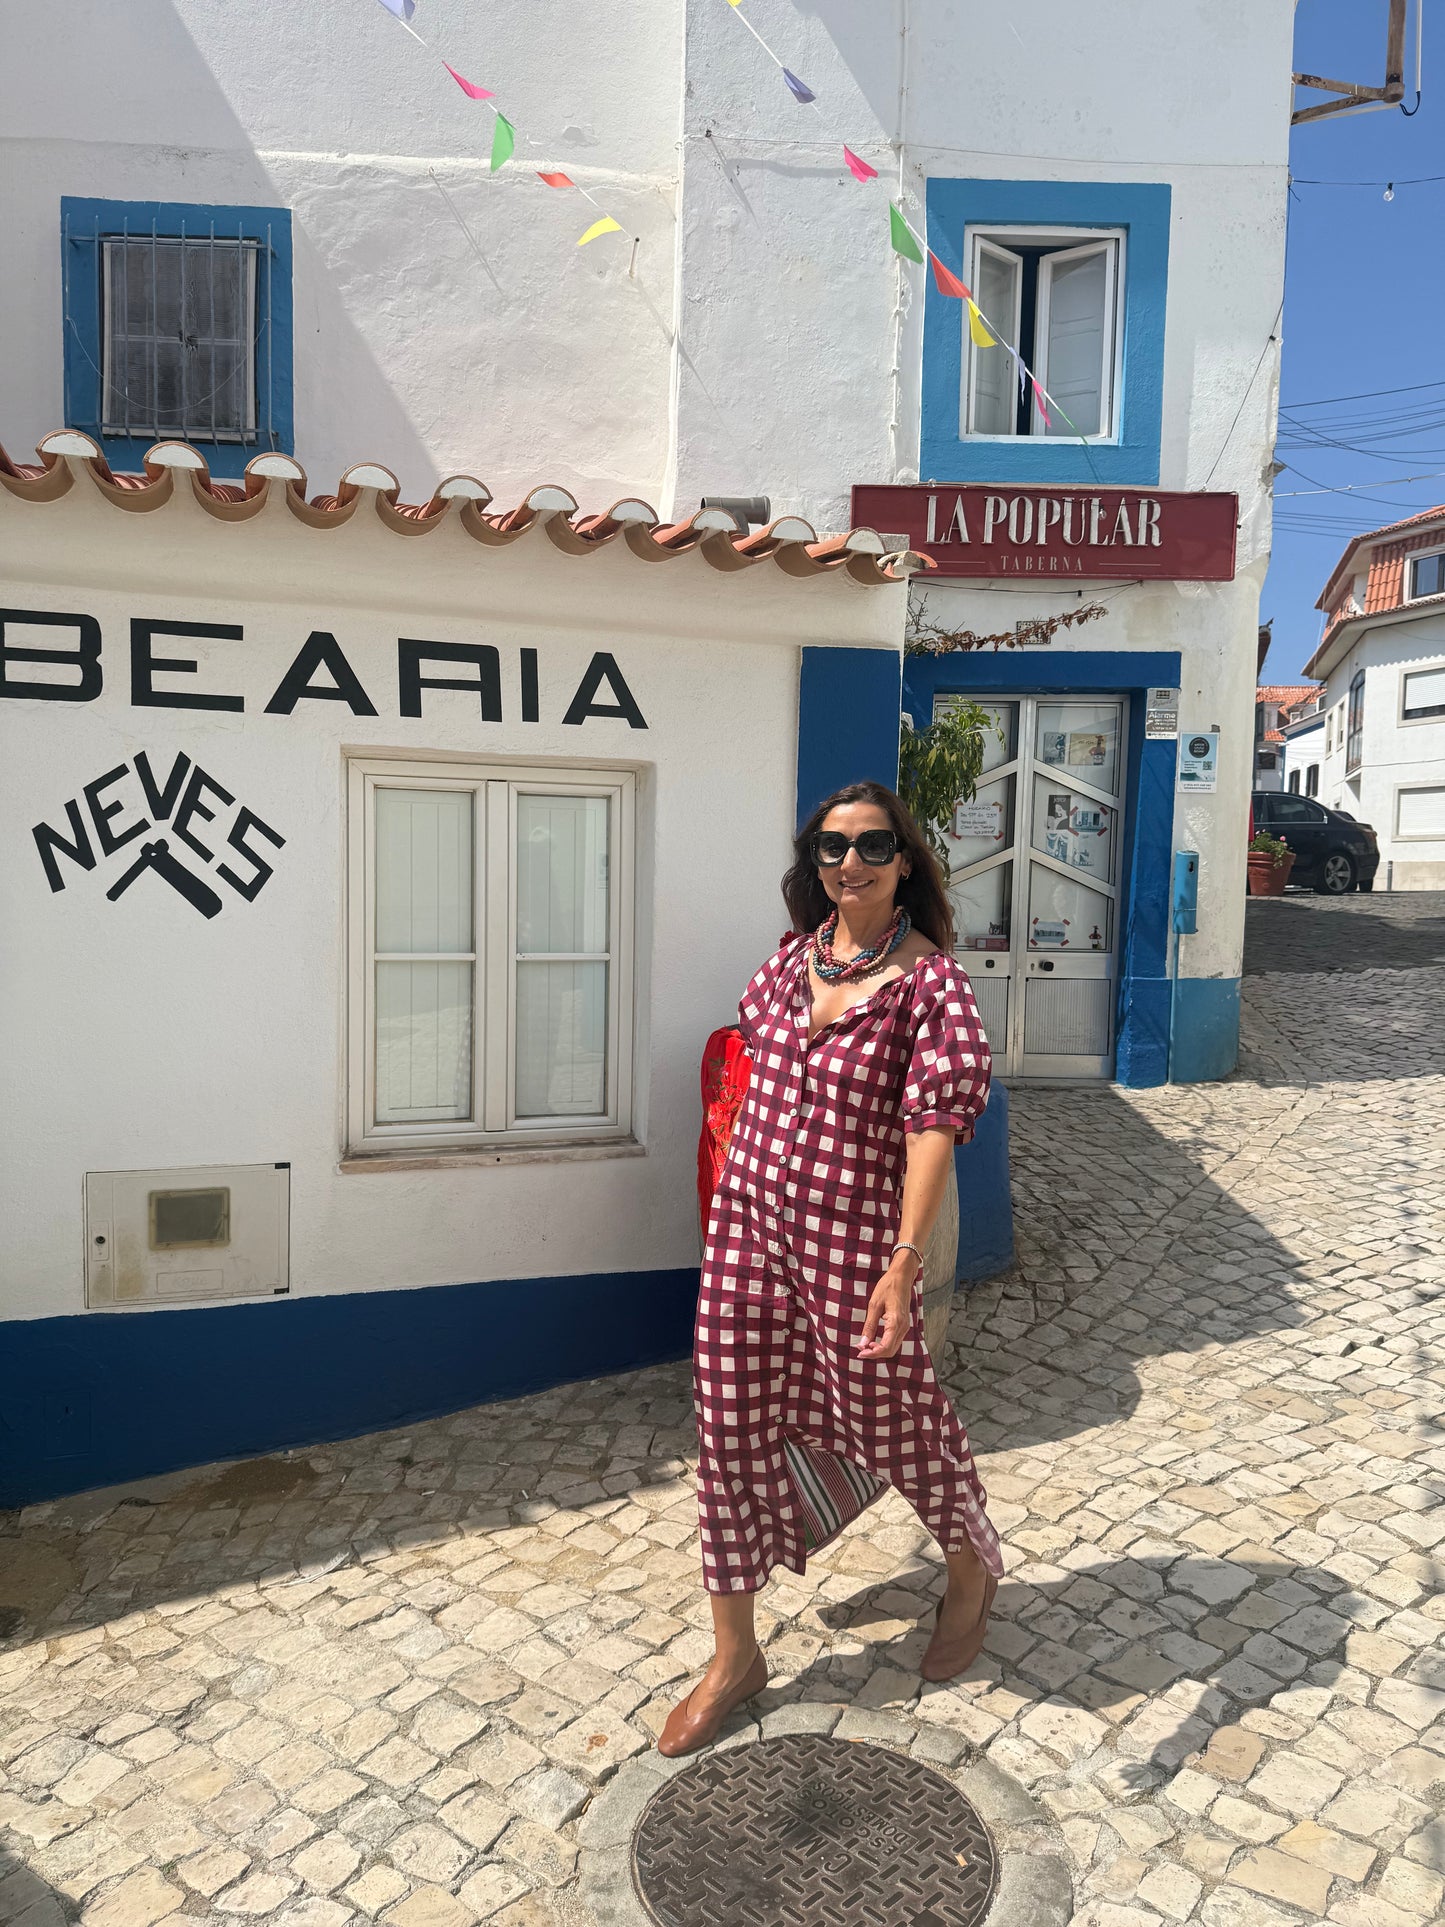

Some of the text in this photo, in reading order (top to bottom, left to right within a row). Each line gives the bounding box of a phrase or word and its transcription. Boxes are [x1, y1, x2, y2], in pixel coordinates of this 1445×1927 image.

[924, 494, 1163, 547] LA POPULAR
[1000, 555, 1083, 572] TABERNA
[32, 751, 287, 903] NEVES
[797, 1788, 899, 1857] ESGOTOS
[813, 1781, 908, 1845] DOMESTICOS
